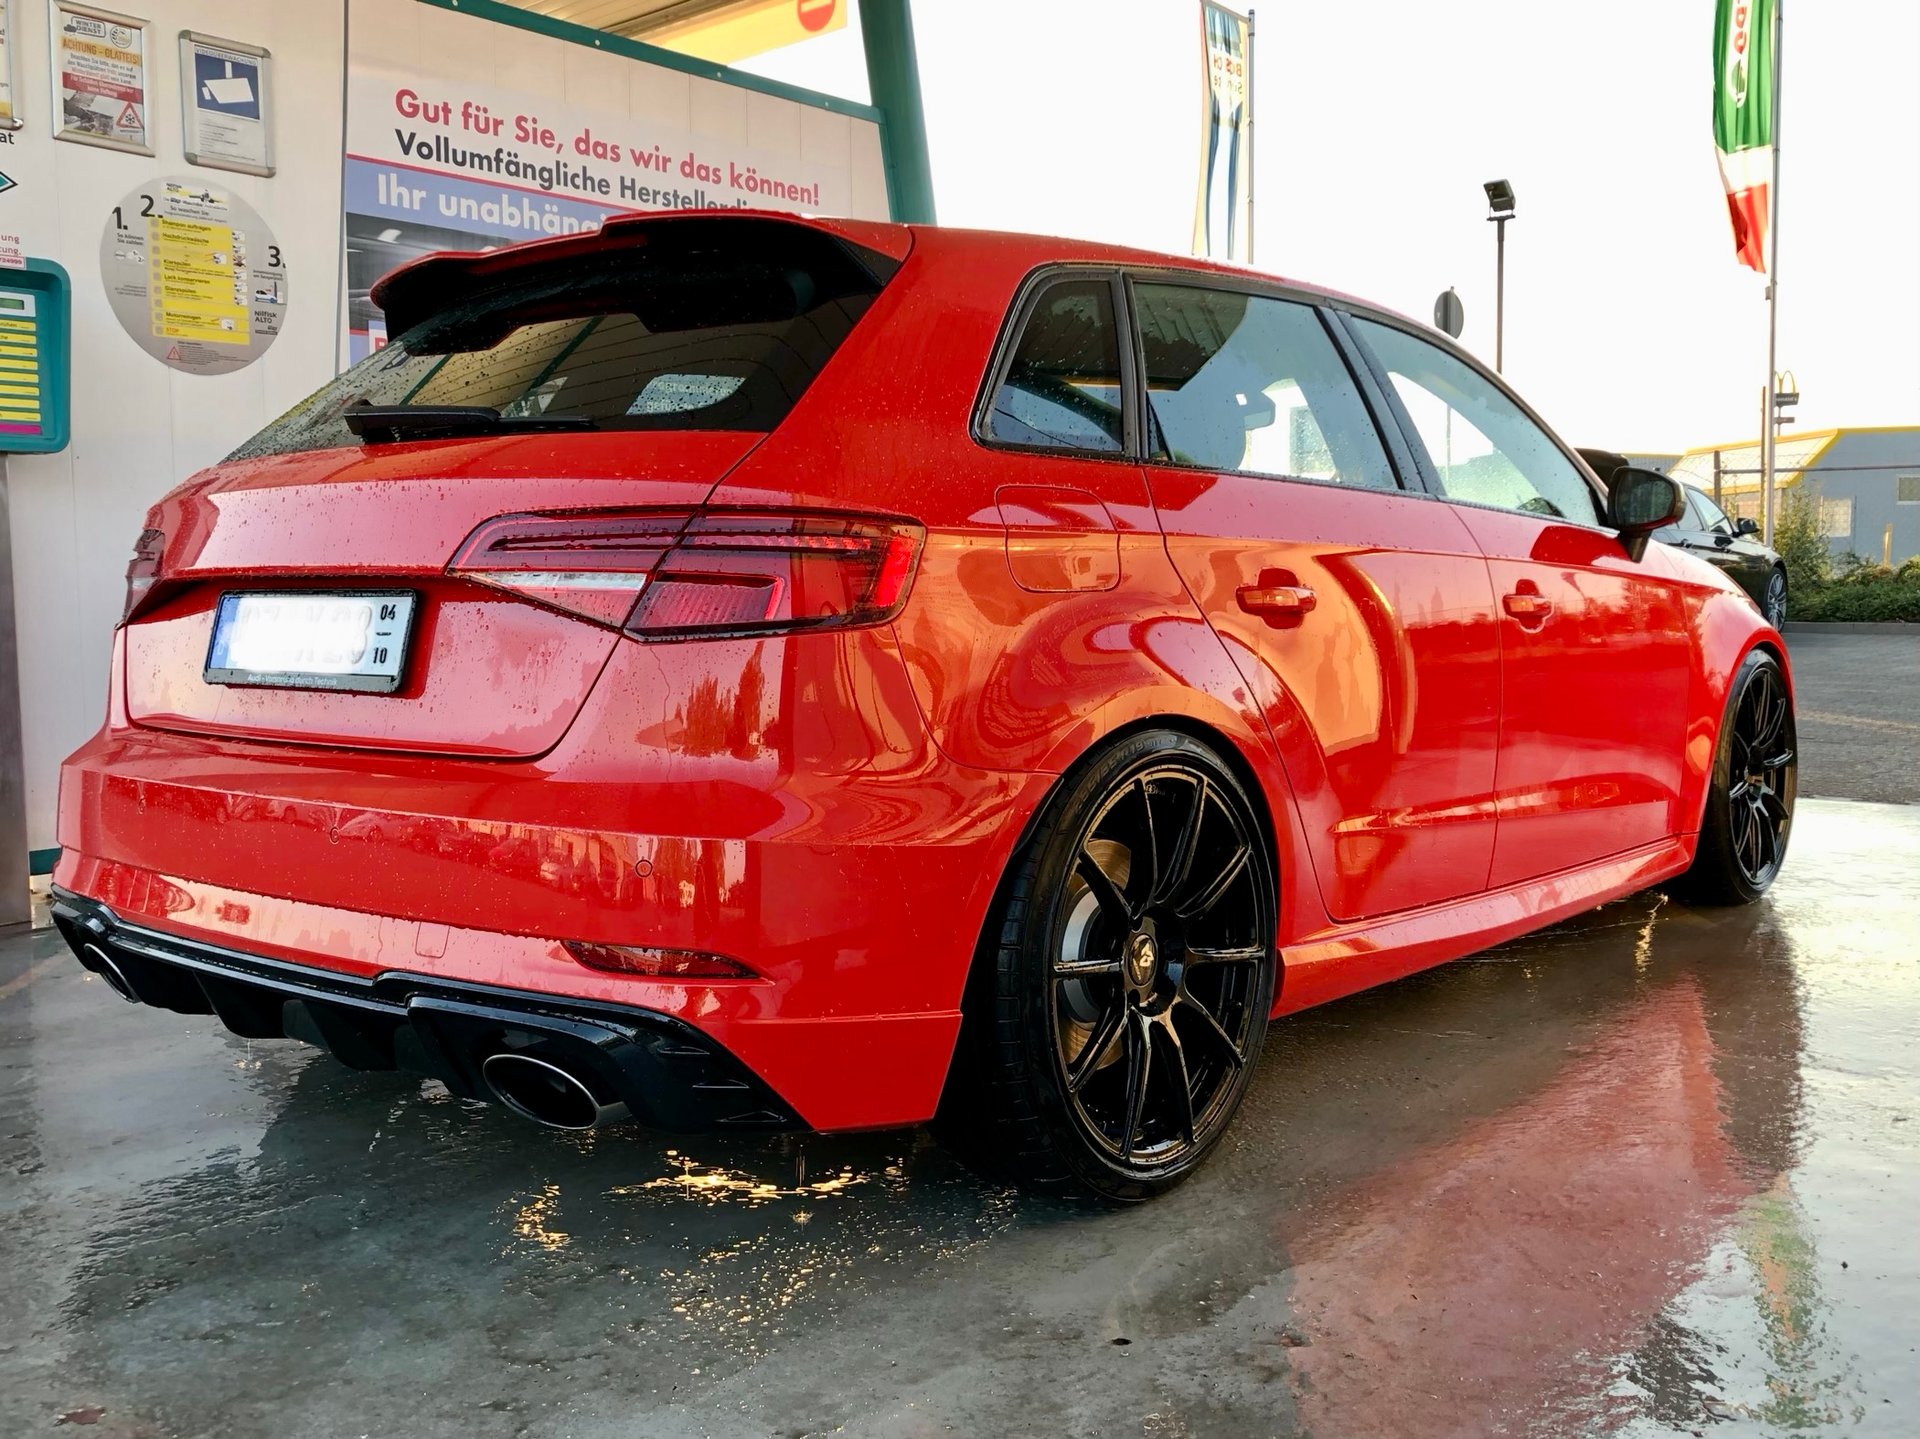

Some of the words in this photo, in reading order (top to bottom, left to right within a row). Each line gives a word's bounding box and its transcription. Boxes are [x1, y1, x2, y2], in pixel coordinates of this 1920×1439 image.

[63, 39, 97, 55] ACHTUNG
[395, 89, 452, 126] Gut
[462, 101, 504, 136] für
[515, 115, 564, 154] Sie,
[574, 128, 621, 163] das
[629, 145, 672, 173] wir
[680, 153, 722, 185] das
[729, 162, 819, 206] können!
[395, 128, 611, 195] Vollumfängliche
[377, 173, 427, 210] Ihr
[112, 206, 128, 230] 1.
[140, 195, 163, 218] 2.
[268, 246, 286, 269] 3.
[380, 604, 396, 621] 04
[372, 647, 387, 664] 10
